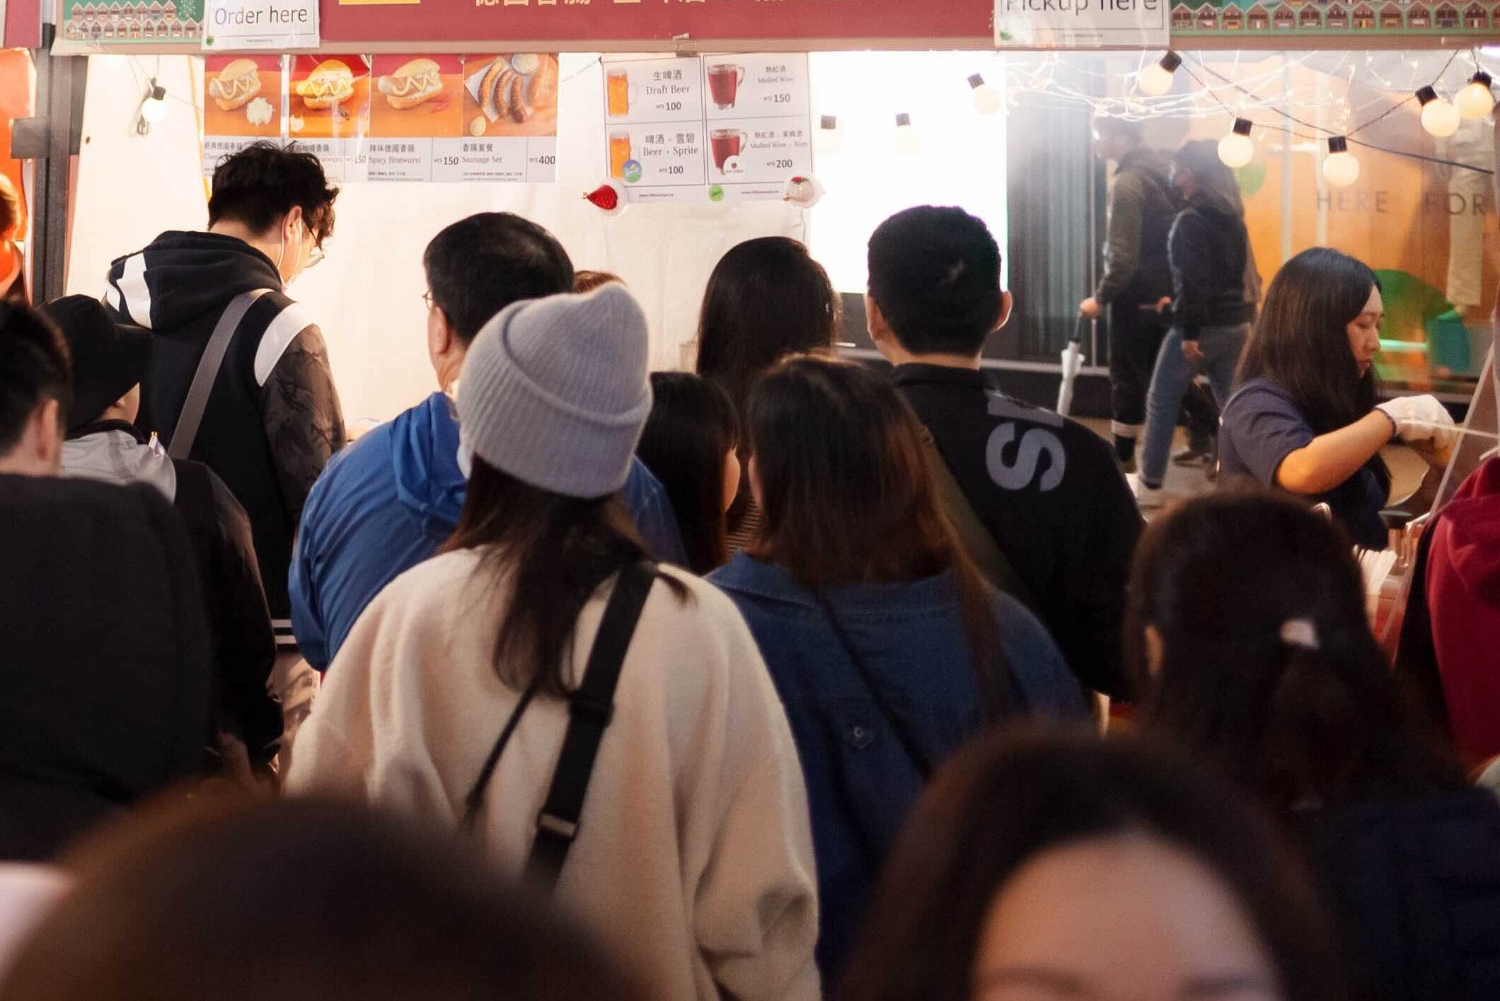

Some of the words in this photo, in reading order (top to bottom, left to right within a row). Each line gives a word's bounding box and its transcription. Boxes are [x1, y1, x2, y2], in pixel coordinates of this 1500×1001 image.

[215, 6, 263, 25] Order
[269, 5, 308, 23] here
[646, 85, 668, 95] Draft
[671, 85, 690, 94] Beer
[643, 147, 662, 157] Beer
[673, 147, 698, 157] Sprite
[492, 155, 503, 164] Set
[1316, 191, 1388, 213] HERE
